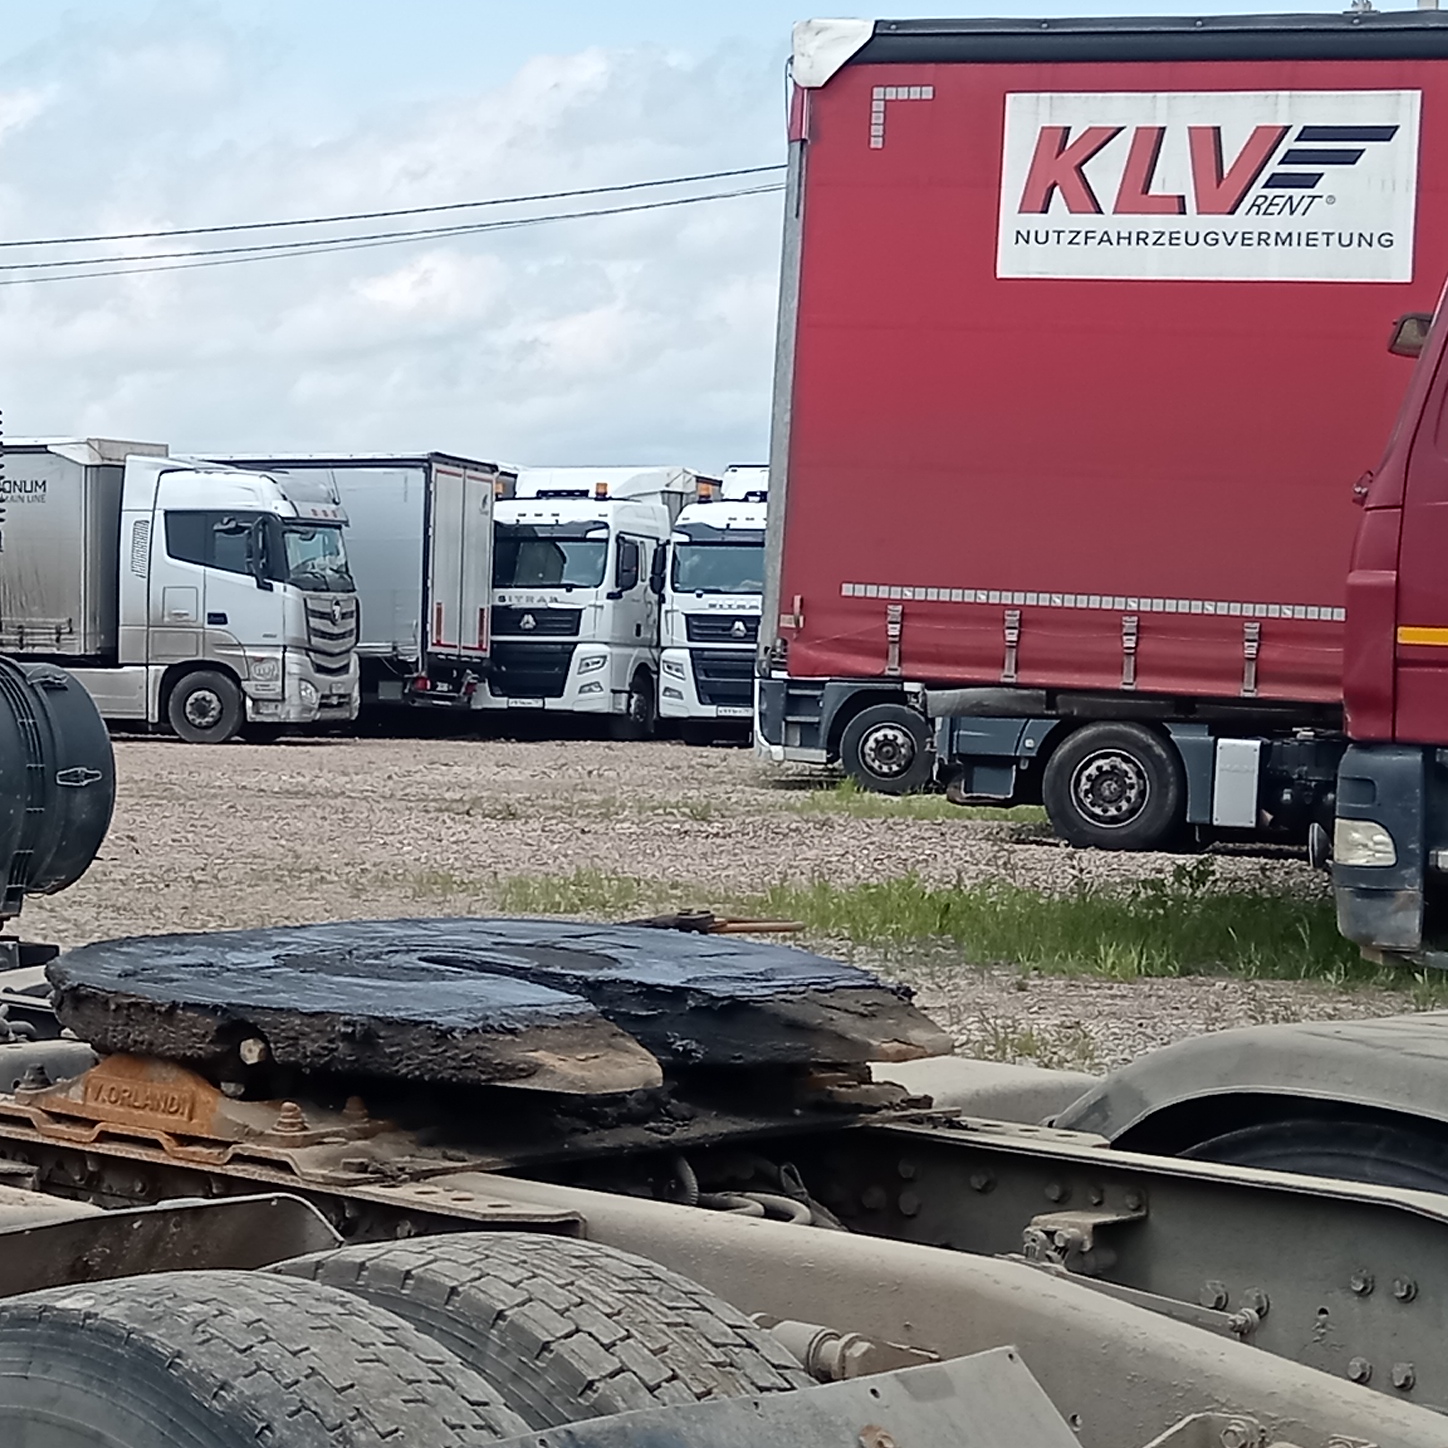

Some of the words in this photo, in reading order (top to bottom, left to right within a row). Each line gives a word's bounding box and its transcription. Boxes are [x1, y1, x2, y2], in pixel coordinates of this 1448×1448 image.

[1017, 125, 1293, 216] KLV
[1245, 194, 1323, 216] RENT
[1013, 228, 1395, 249] NUTZFAHRZEUGVERMIETUNG
